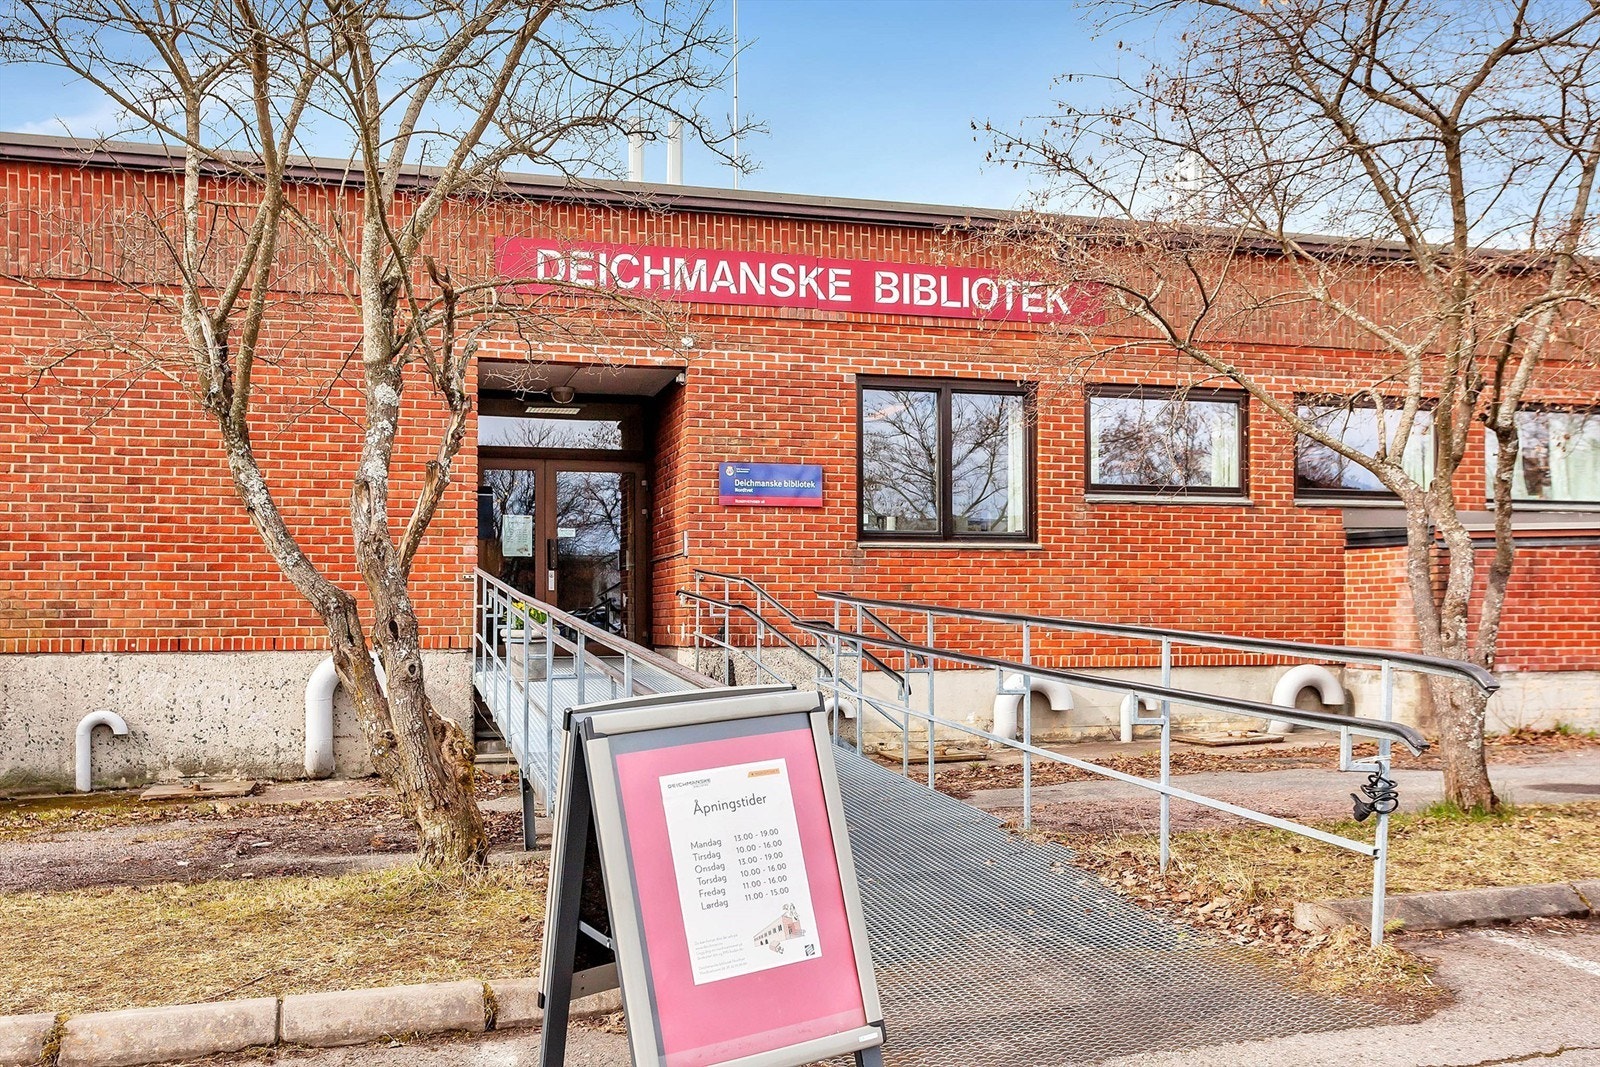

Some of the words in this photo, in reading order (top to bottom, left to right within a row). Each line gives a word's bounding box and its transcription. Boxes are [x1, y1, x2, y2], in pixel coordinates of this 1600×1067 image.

[536, 249, 852, 303] DEICHMANSKE
[874, 270, 1071, 315] BIBLIOTEK
[734, 479, 782, 488] Deichmanske
[783, 480, 816, 488] bibliotek
[693, 793, 767, 816] Åpningstider
[690, 838, 722, 850] Mandag
[733, 832, 754, 842] 13.00
[760, 828, 779, 838] 19.00
[692, 850, 721, 861] Tirsdag
[736, 844, 757, 854] 10.00
[763, 839, 783, 849] 16.00
[694, 862, 725, 874] Onsdag
[738, 856, 758, 866] 13.00
[764, 851, 783, 861] 19.00
[697, 874, 727, 886] Torsdag
[740, 867, 761, 877] 10.00
[767, 862, 787, 872] 16.00
[698, 887, 726, 898] Fredag
[742, 879, 761, 889] 11.00
[768, 874, 788, 884] 16.00
[701, 899, 729, 911] Lørdag
[745, 891, 764, 901] 11.00
[770, 886, 789, 896] 15.00
